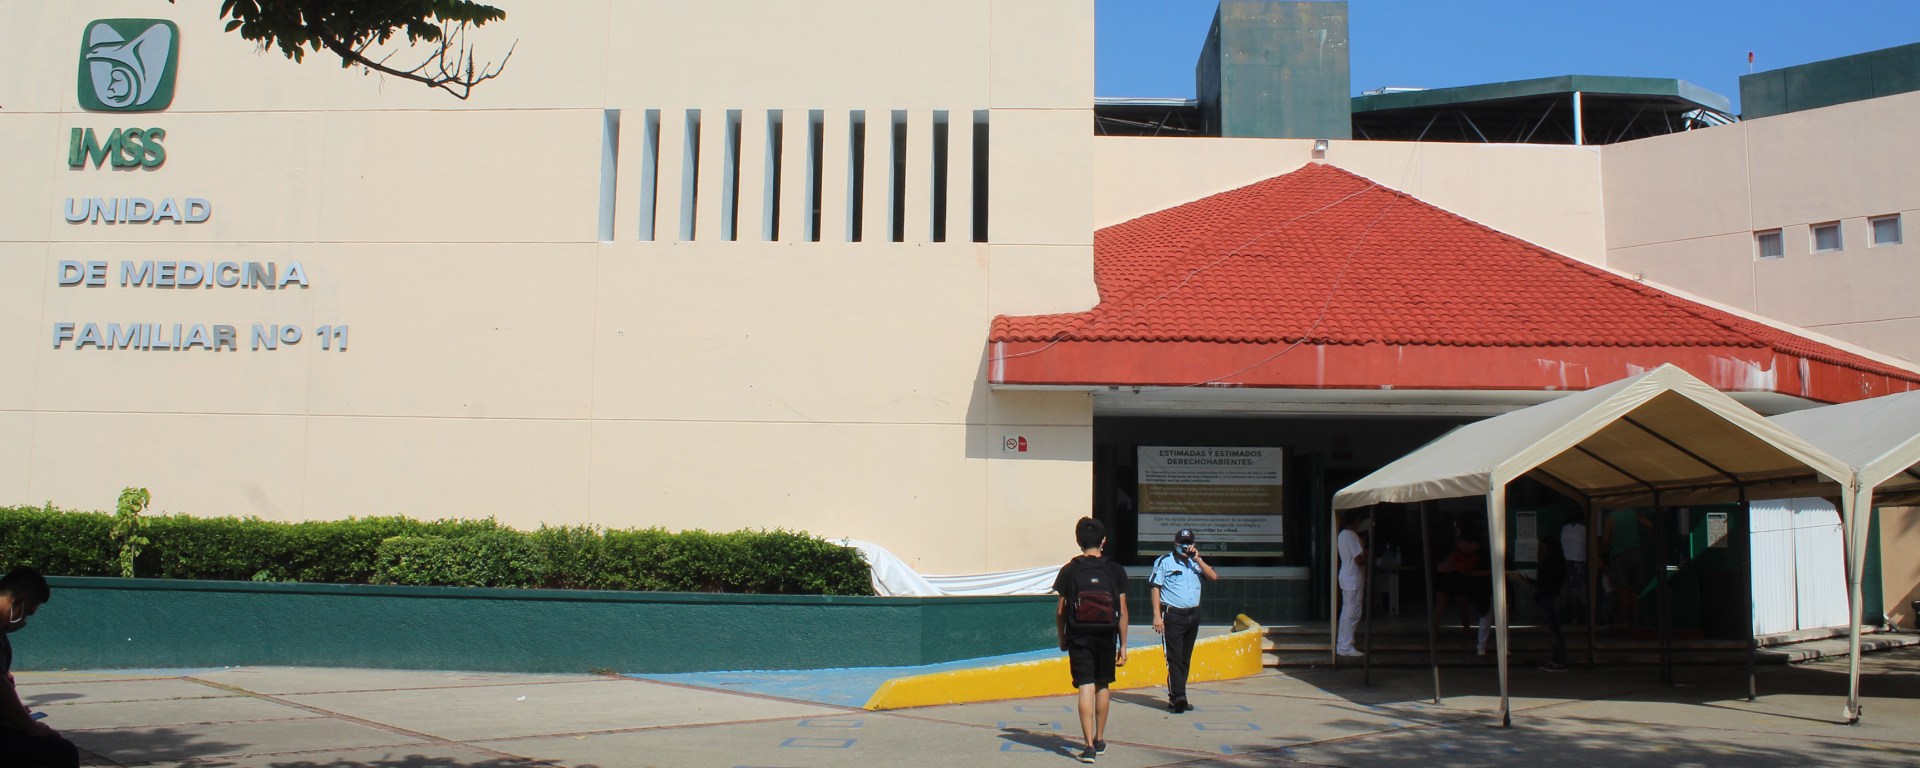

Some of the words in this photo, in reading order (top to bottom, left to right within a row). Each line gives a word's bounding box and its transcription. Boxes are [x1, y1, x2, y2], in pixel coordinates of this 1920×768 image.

[68, 127, 166, 168] IMSS
[65, 197, 212, 224] UNIDAD
[58, 260, 107, 287] DE
[120, 260, 309, 289] MEDICINA
[52, 322, 237, 351] FAMILIAR
[316, 324, 348, 351] 11
[1215, 450, 1262, 458] ESTIMADOS
